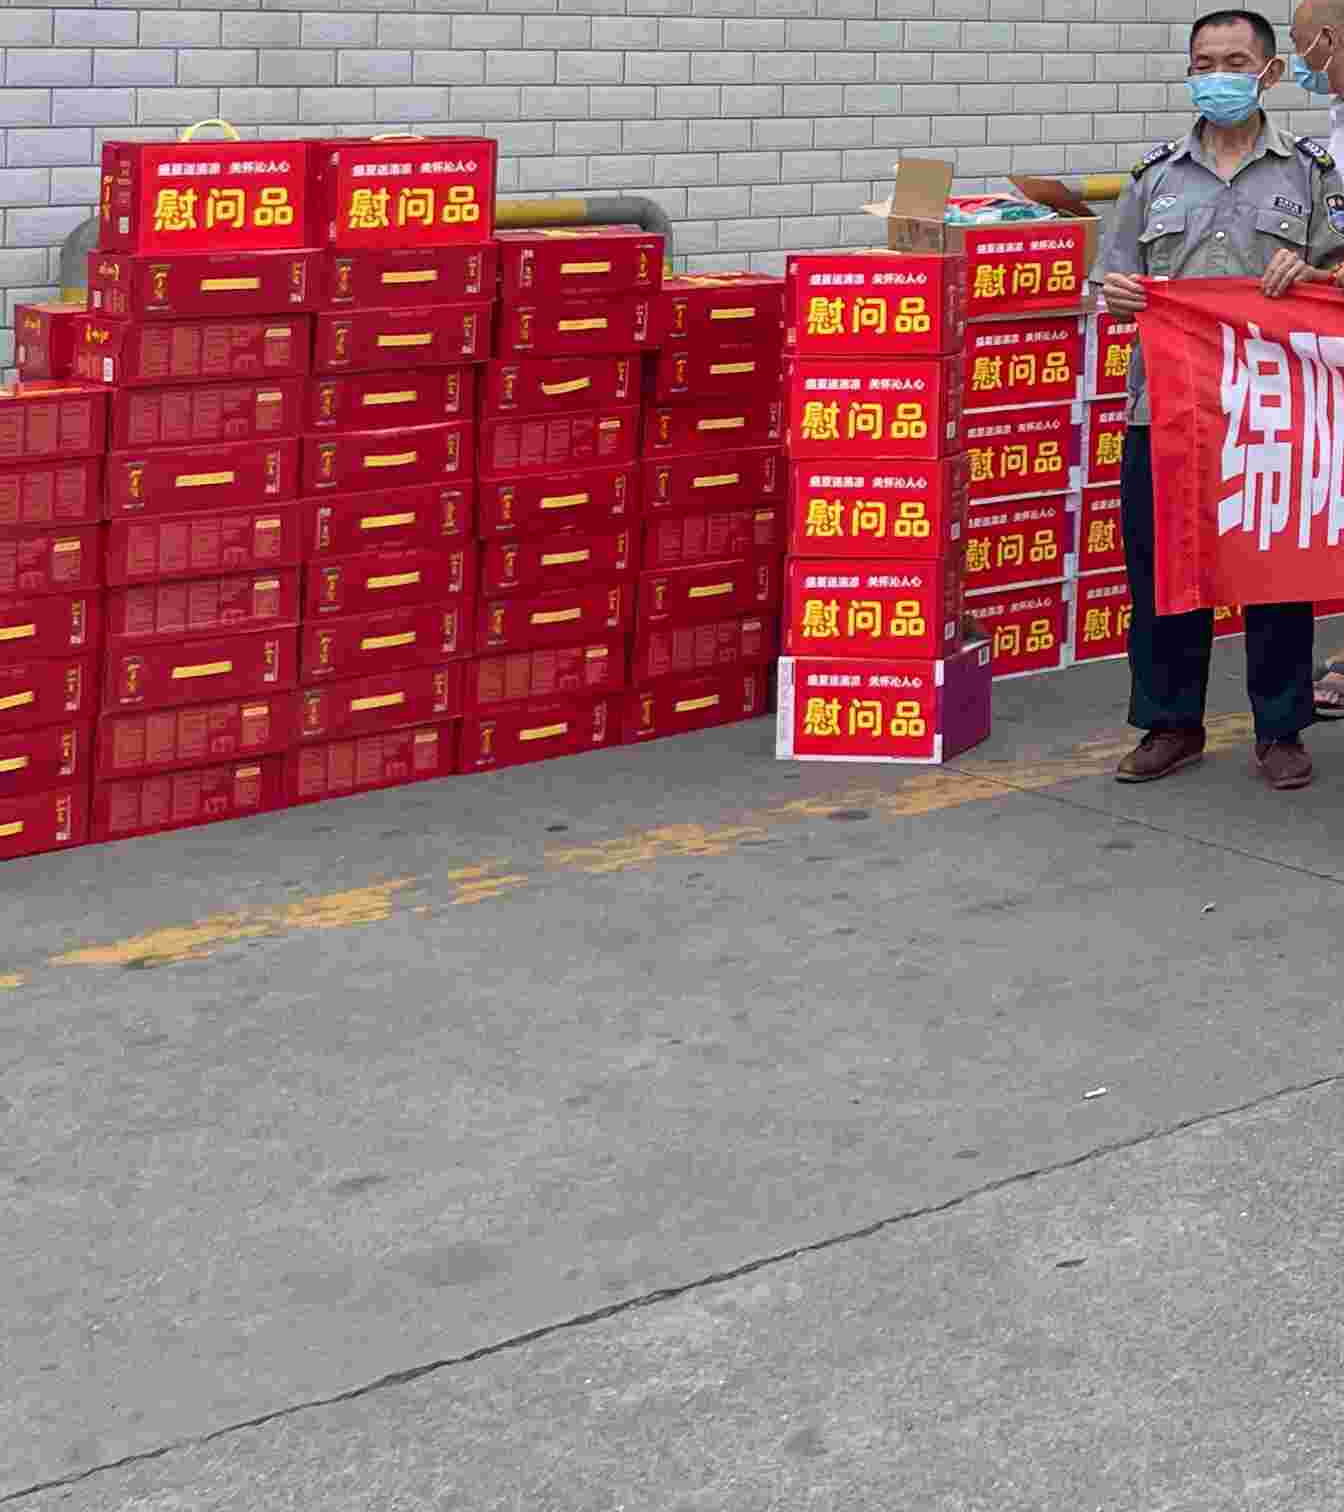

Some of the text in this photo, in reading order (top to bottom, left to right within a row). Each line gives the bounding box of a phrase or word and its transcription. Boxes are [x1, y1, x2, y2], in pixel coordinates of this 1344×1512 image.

[153, 186, 294, 232] 慰问品
[347, 185, 481, 231] 慰问品
[973, 260, 1077, 299] 慰问品
[807, 296, 931, 335] 慰问品
[972, 351, 1070, 391] 慰问品
[802, 400, 928, 440] 慰问品
[806, 498, 930, 537] 慰问品
[802, 599, 926, 638] 慰问品
[804, 697, 926, 737] 慰问品
